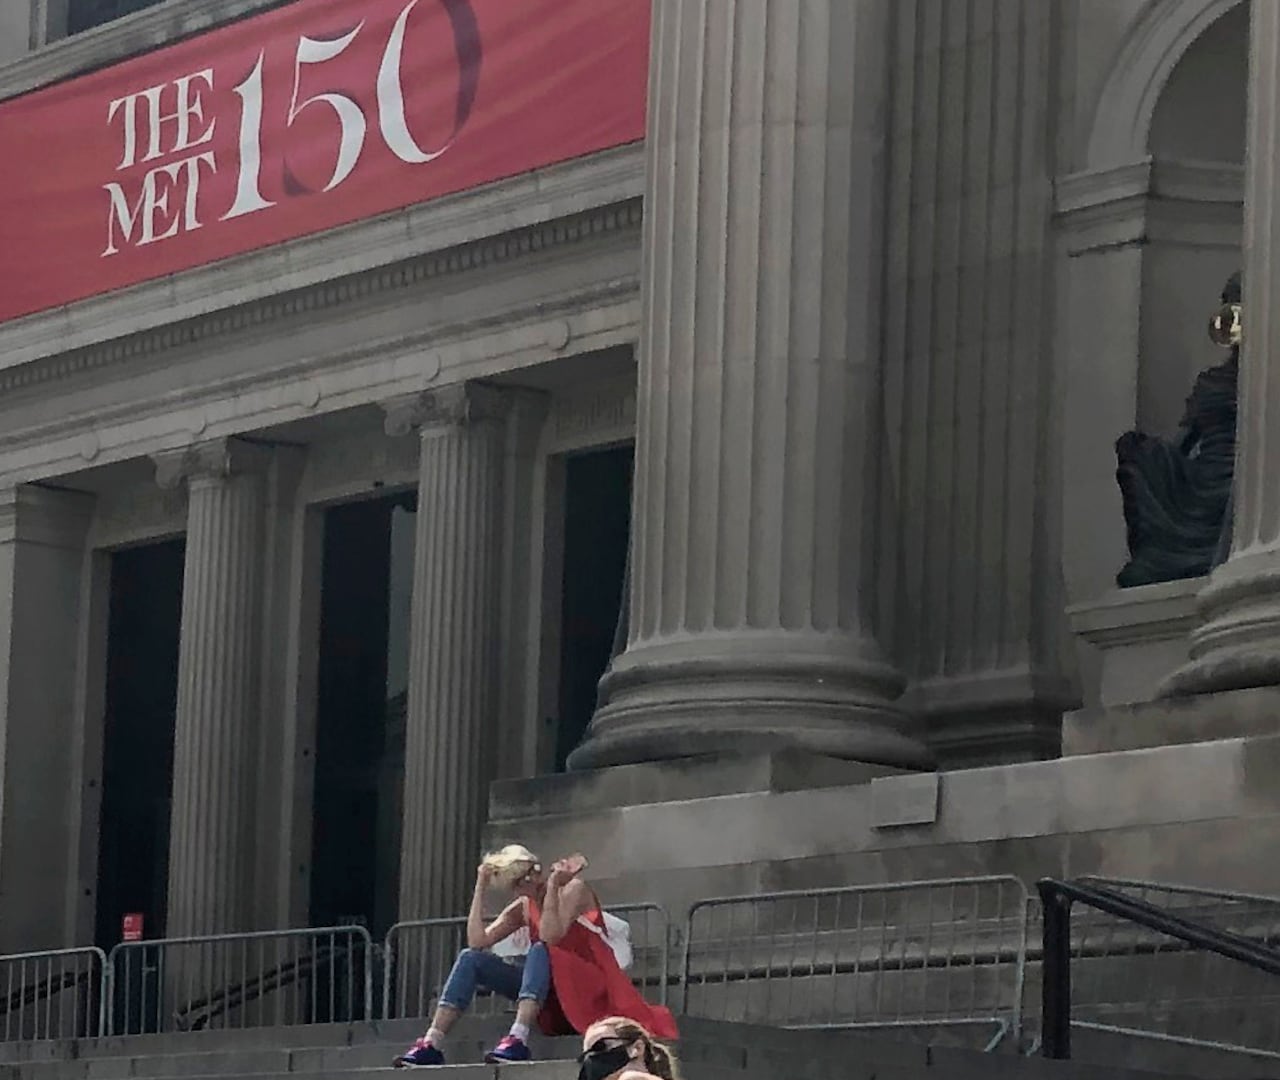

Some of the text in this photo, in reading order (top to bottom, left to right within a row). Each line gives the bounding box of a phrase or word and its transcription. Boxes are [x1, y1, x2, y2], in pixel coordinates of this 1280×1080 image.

[107, 68, 216, 171] THE
[218, 0, 482, 221] 150
[101, 151, 217, 257] MET
